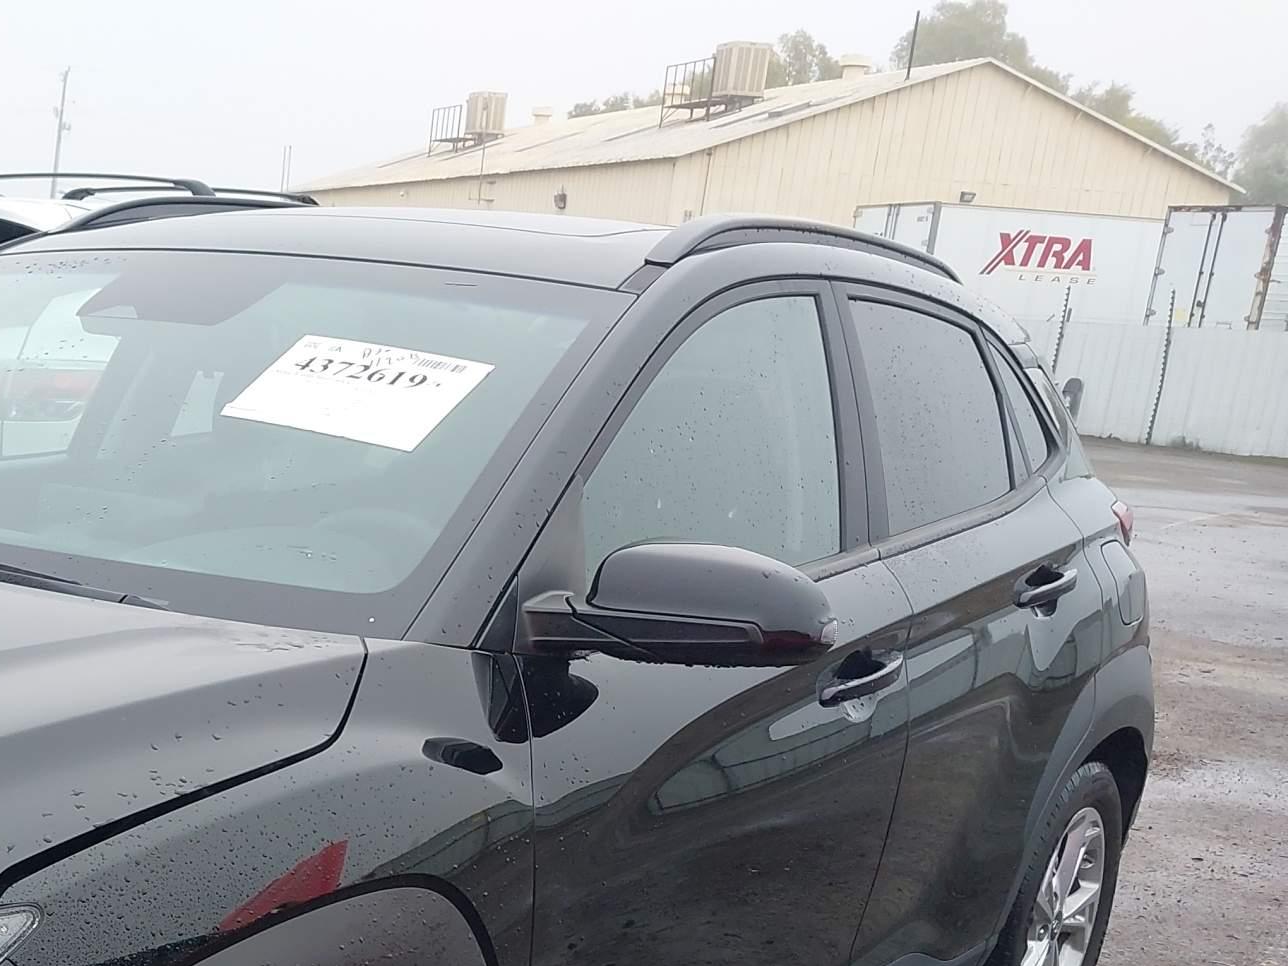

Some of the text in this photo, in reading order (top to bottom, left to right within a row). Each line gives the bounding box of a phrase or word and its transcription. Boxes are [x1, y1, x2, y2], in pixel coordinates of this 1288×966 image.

[981, 229, 1093, 275] XTRA
[1018, 274, 1097, 285] LEASE
[294, 356, 441, 389] 4372619
